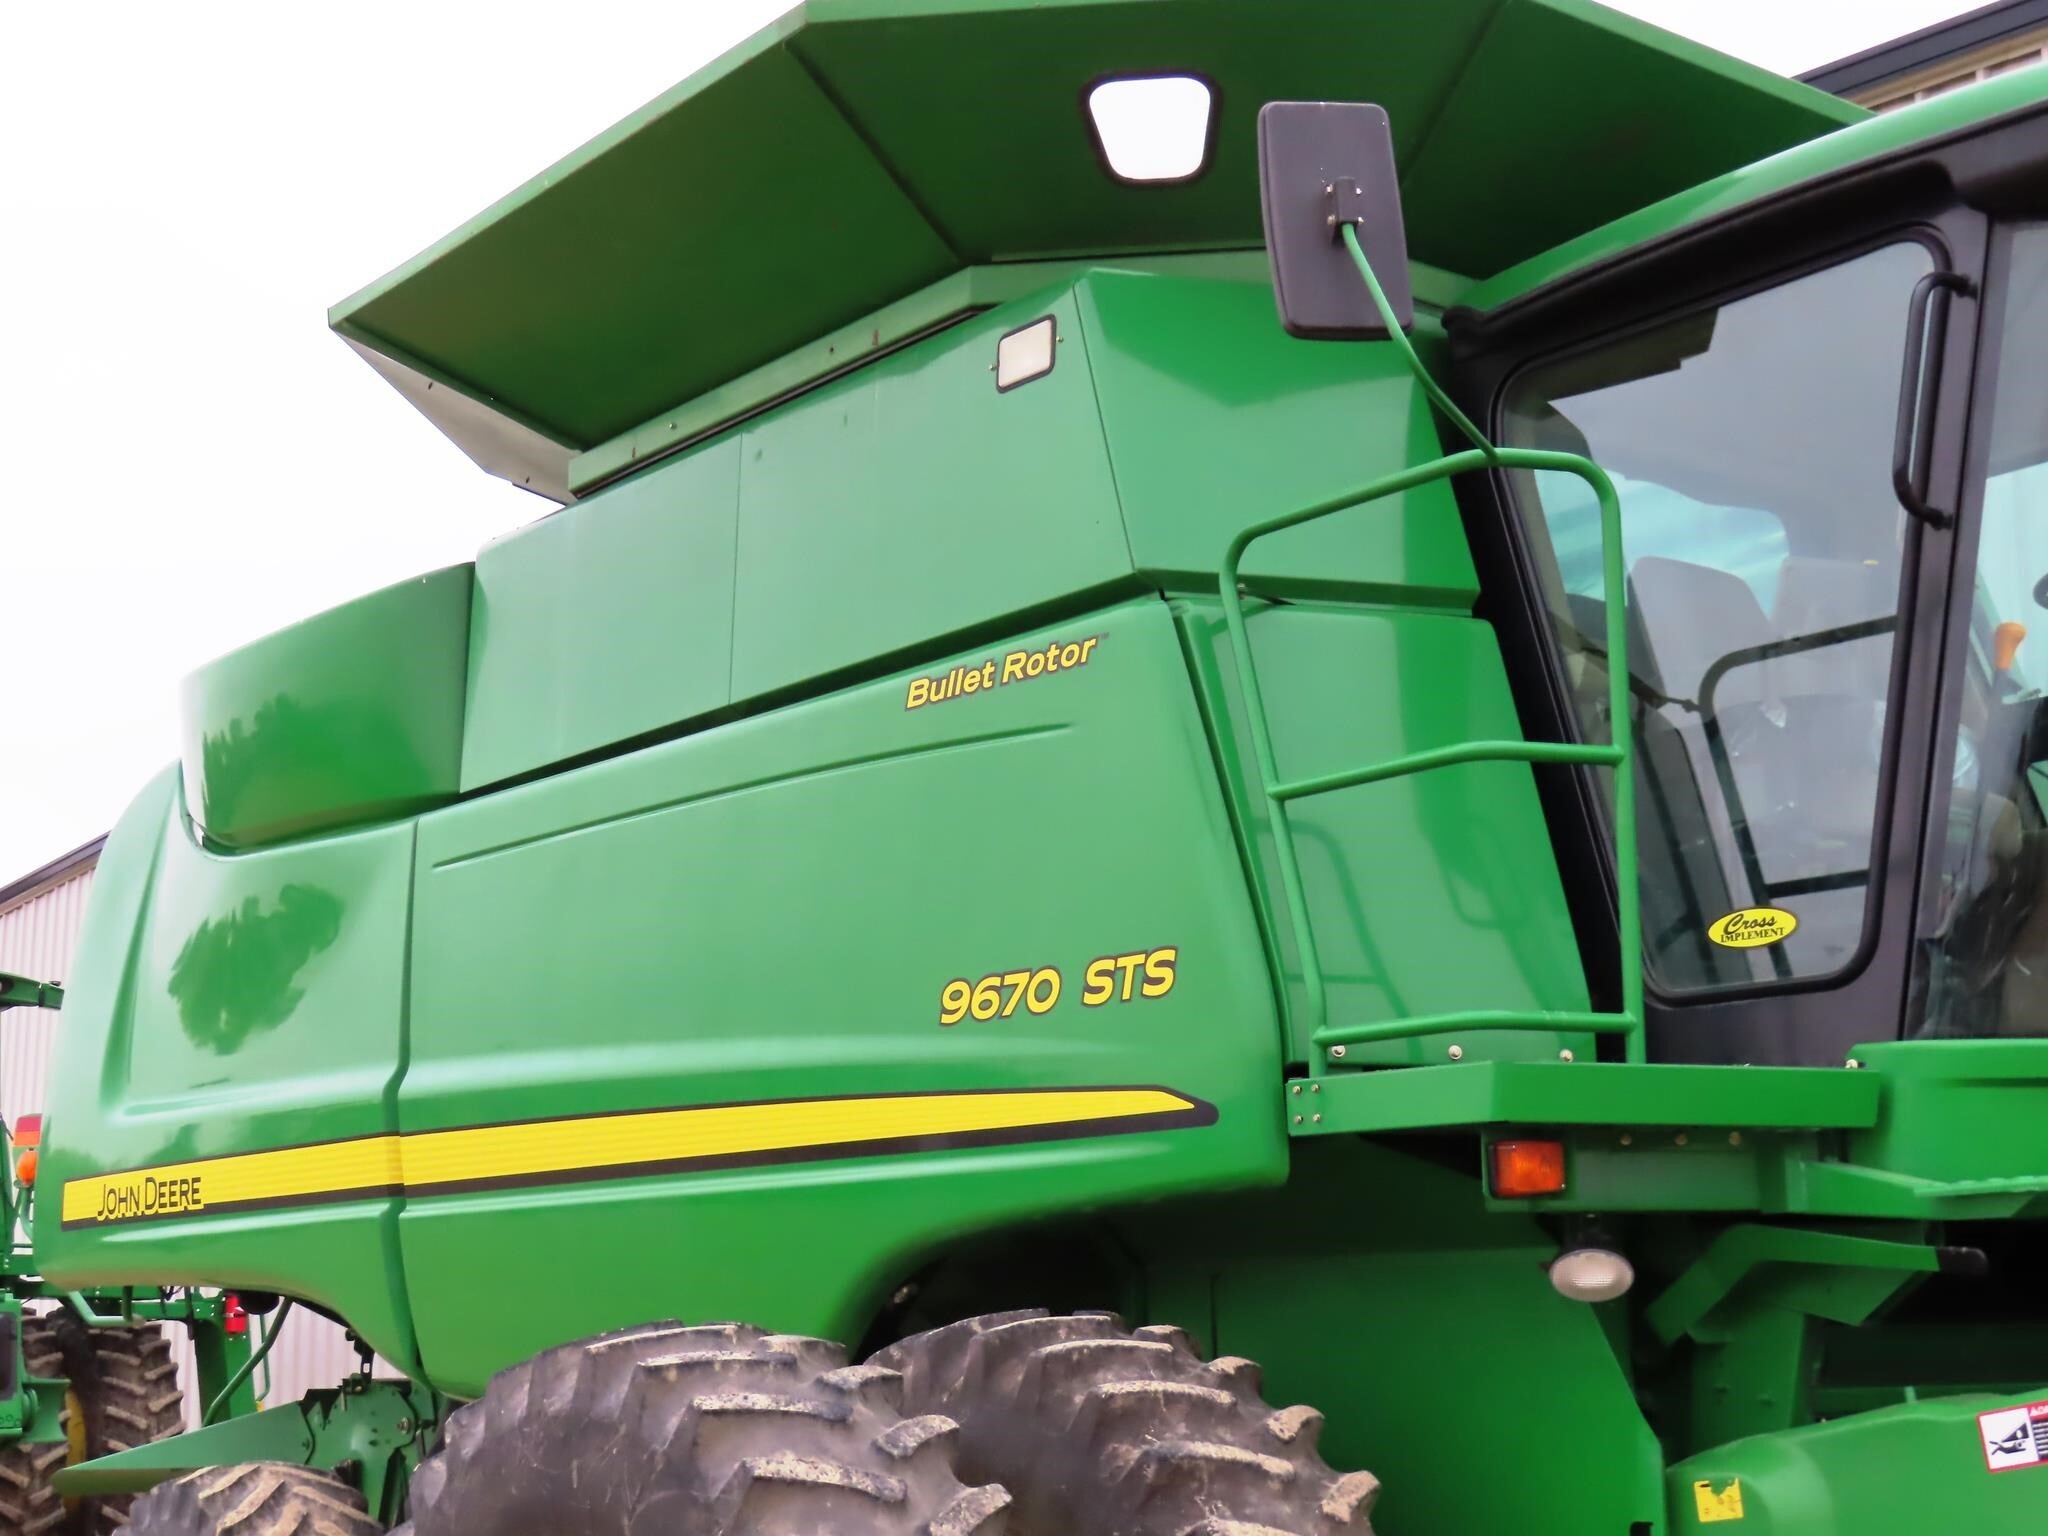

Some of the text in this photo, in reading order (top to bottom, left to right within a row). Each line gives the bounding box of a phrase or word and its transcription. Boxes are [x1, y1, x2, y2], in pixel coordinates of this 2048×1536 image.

[905, 637, 1097, 709] Bullet Rotor
[1720, 927, 1785, 943] IMPLEMENT
[1723, 913, 1777, 935] Cross
[940, 948, 1177, 1025] 9670 STS
[97, 1176, 202, 1217] JOHN DEERE
